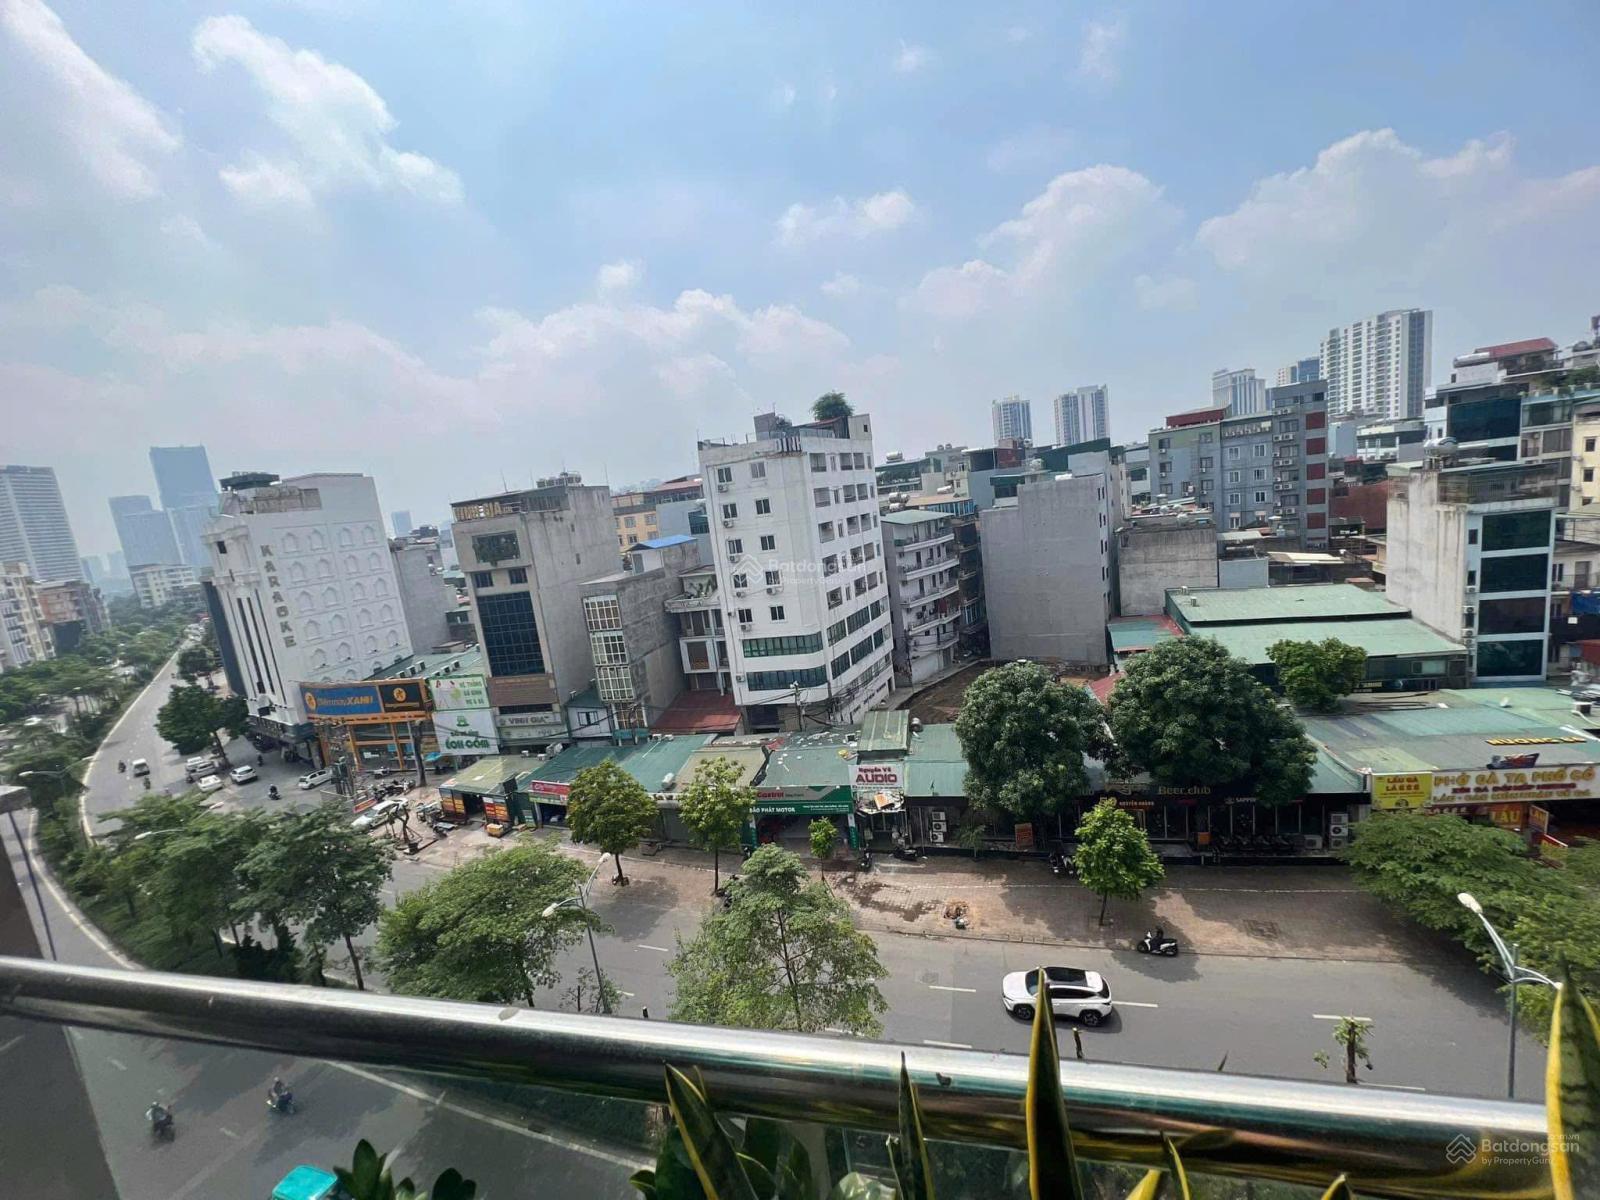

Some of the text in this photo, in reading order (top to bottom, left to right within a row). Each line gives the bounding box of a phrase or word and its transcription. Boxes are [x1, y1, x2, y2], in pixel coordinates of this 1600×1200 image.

[260, 544, 297, 648] KARAOKE
[856, 774, 897, 783] AUDIO
[1475, 771, 1499, 785] GÀ
